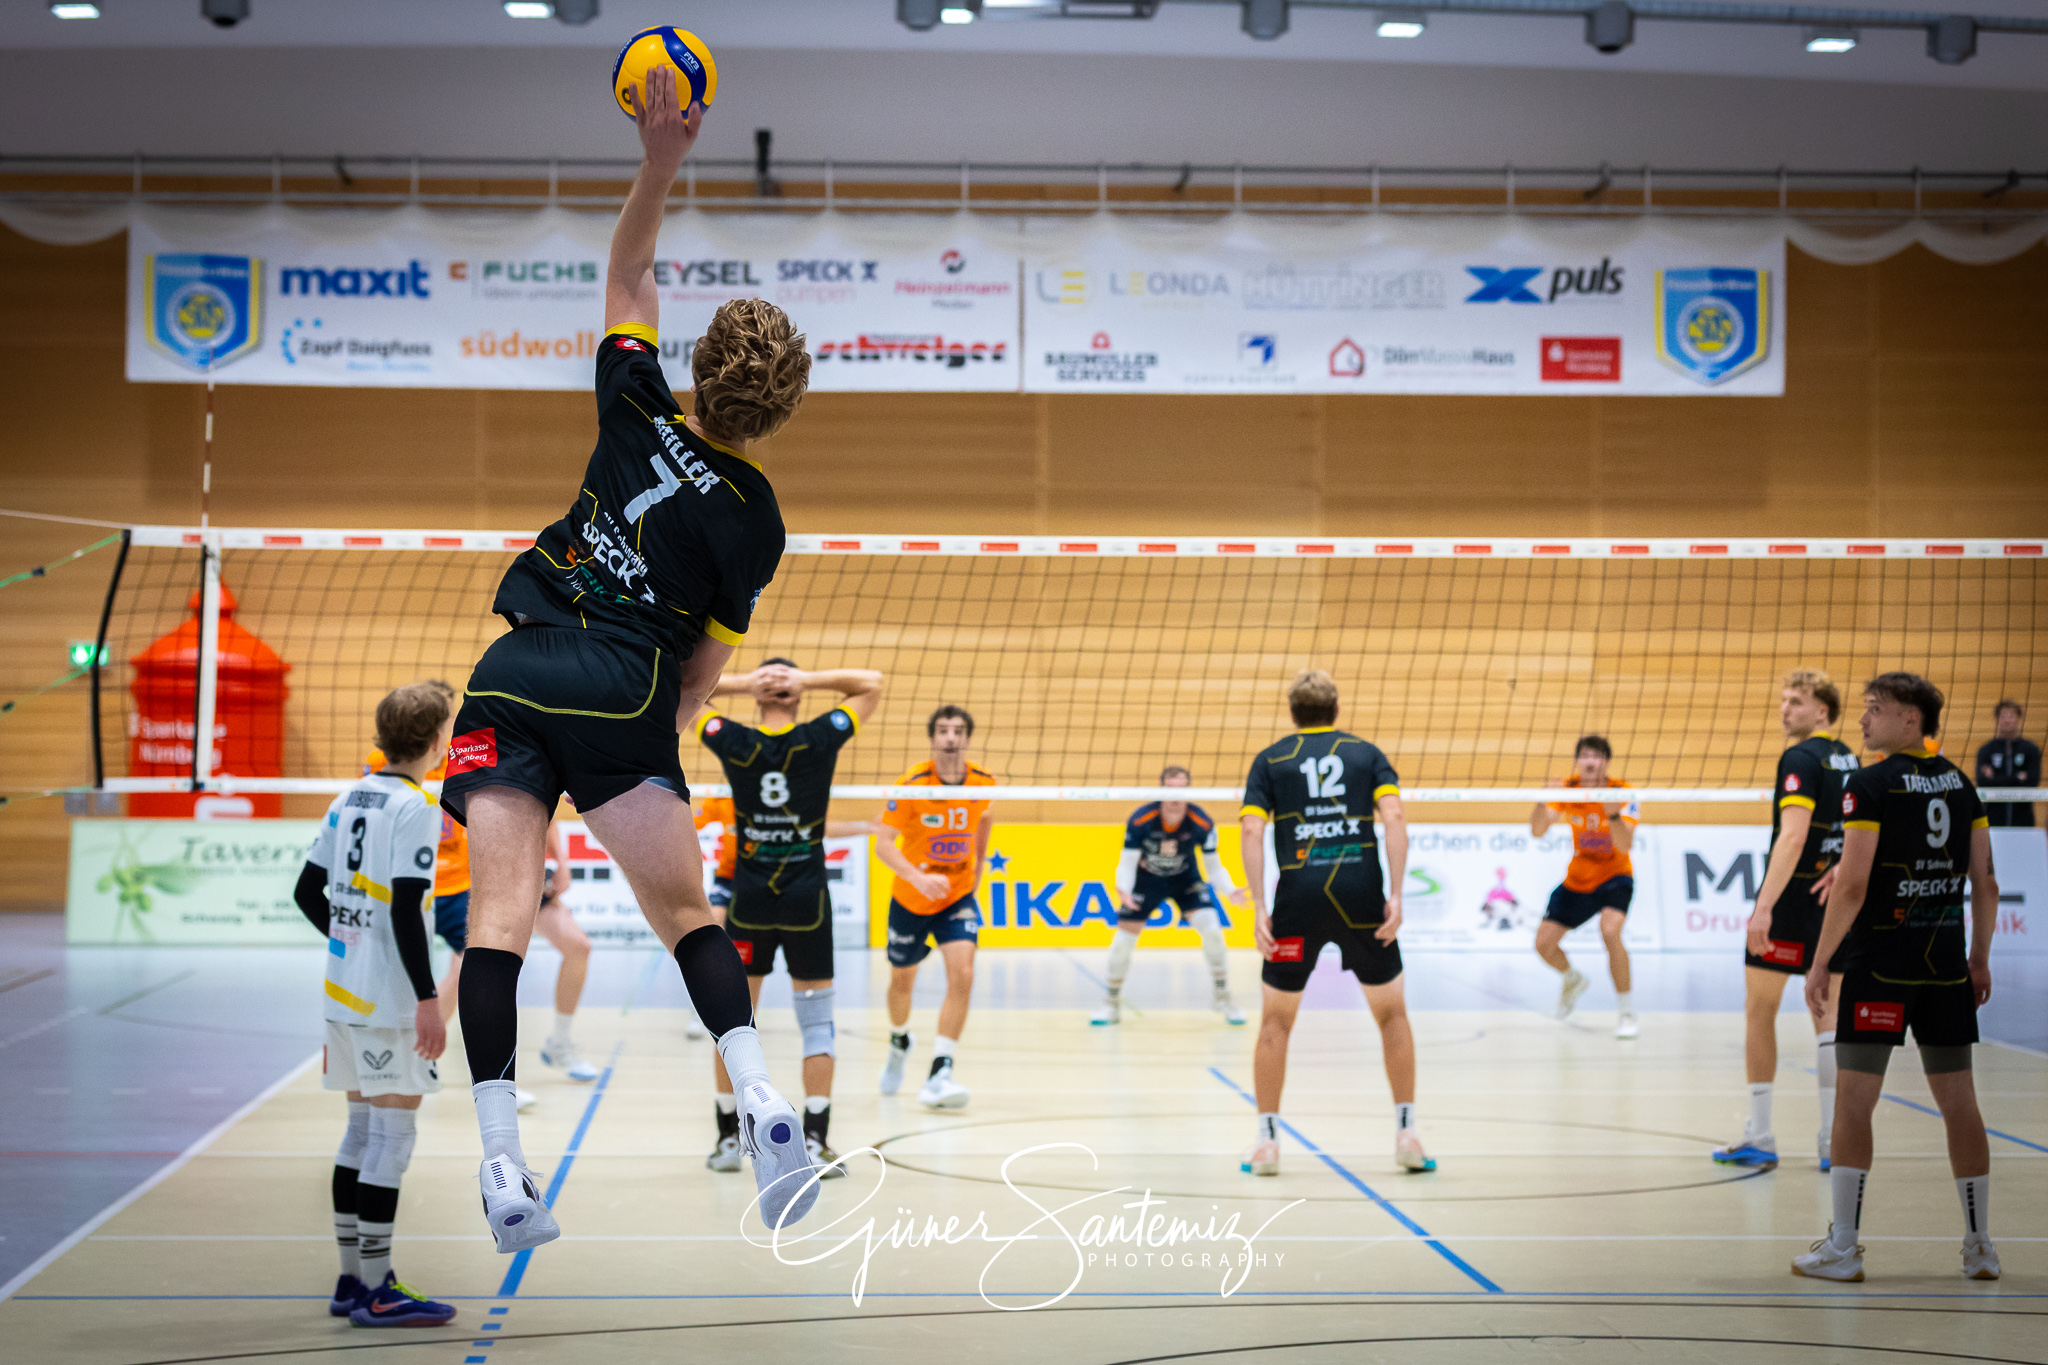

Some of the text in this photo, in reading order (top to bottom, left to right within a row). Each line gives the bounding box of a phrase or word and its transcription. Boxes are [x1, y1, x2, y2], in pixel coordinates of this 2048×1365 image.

[281, 260, 430, 298] maxit
[483, 261, 598, 282] FUCHS
[654, 260, 761, 286] EYSEL
[777, 260, 853, 281] SPECK
[1110, 271, 1230, 296] LEONDA
[1549, 257, 1624, 303] puls
[461, 331, 596, 358] südwoll
[623, 452, 682, 525] 7
[455, 743, 490, 756] Sparkasse
[760, 771, 790, 808] 8
[1300, 755, 1346, 798] 12
[948, 807, 968, 830] 13
[1926, 798, 1950, 848] 9
[181, 835, 304, 863] Tavern
[347, 817, 366, 872] 3
[975, 881, 1231, 928] IKAA
